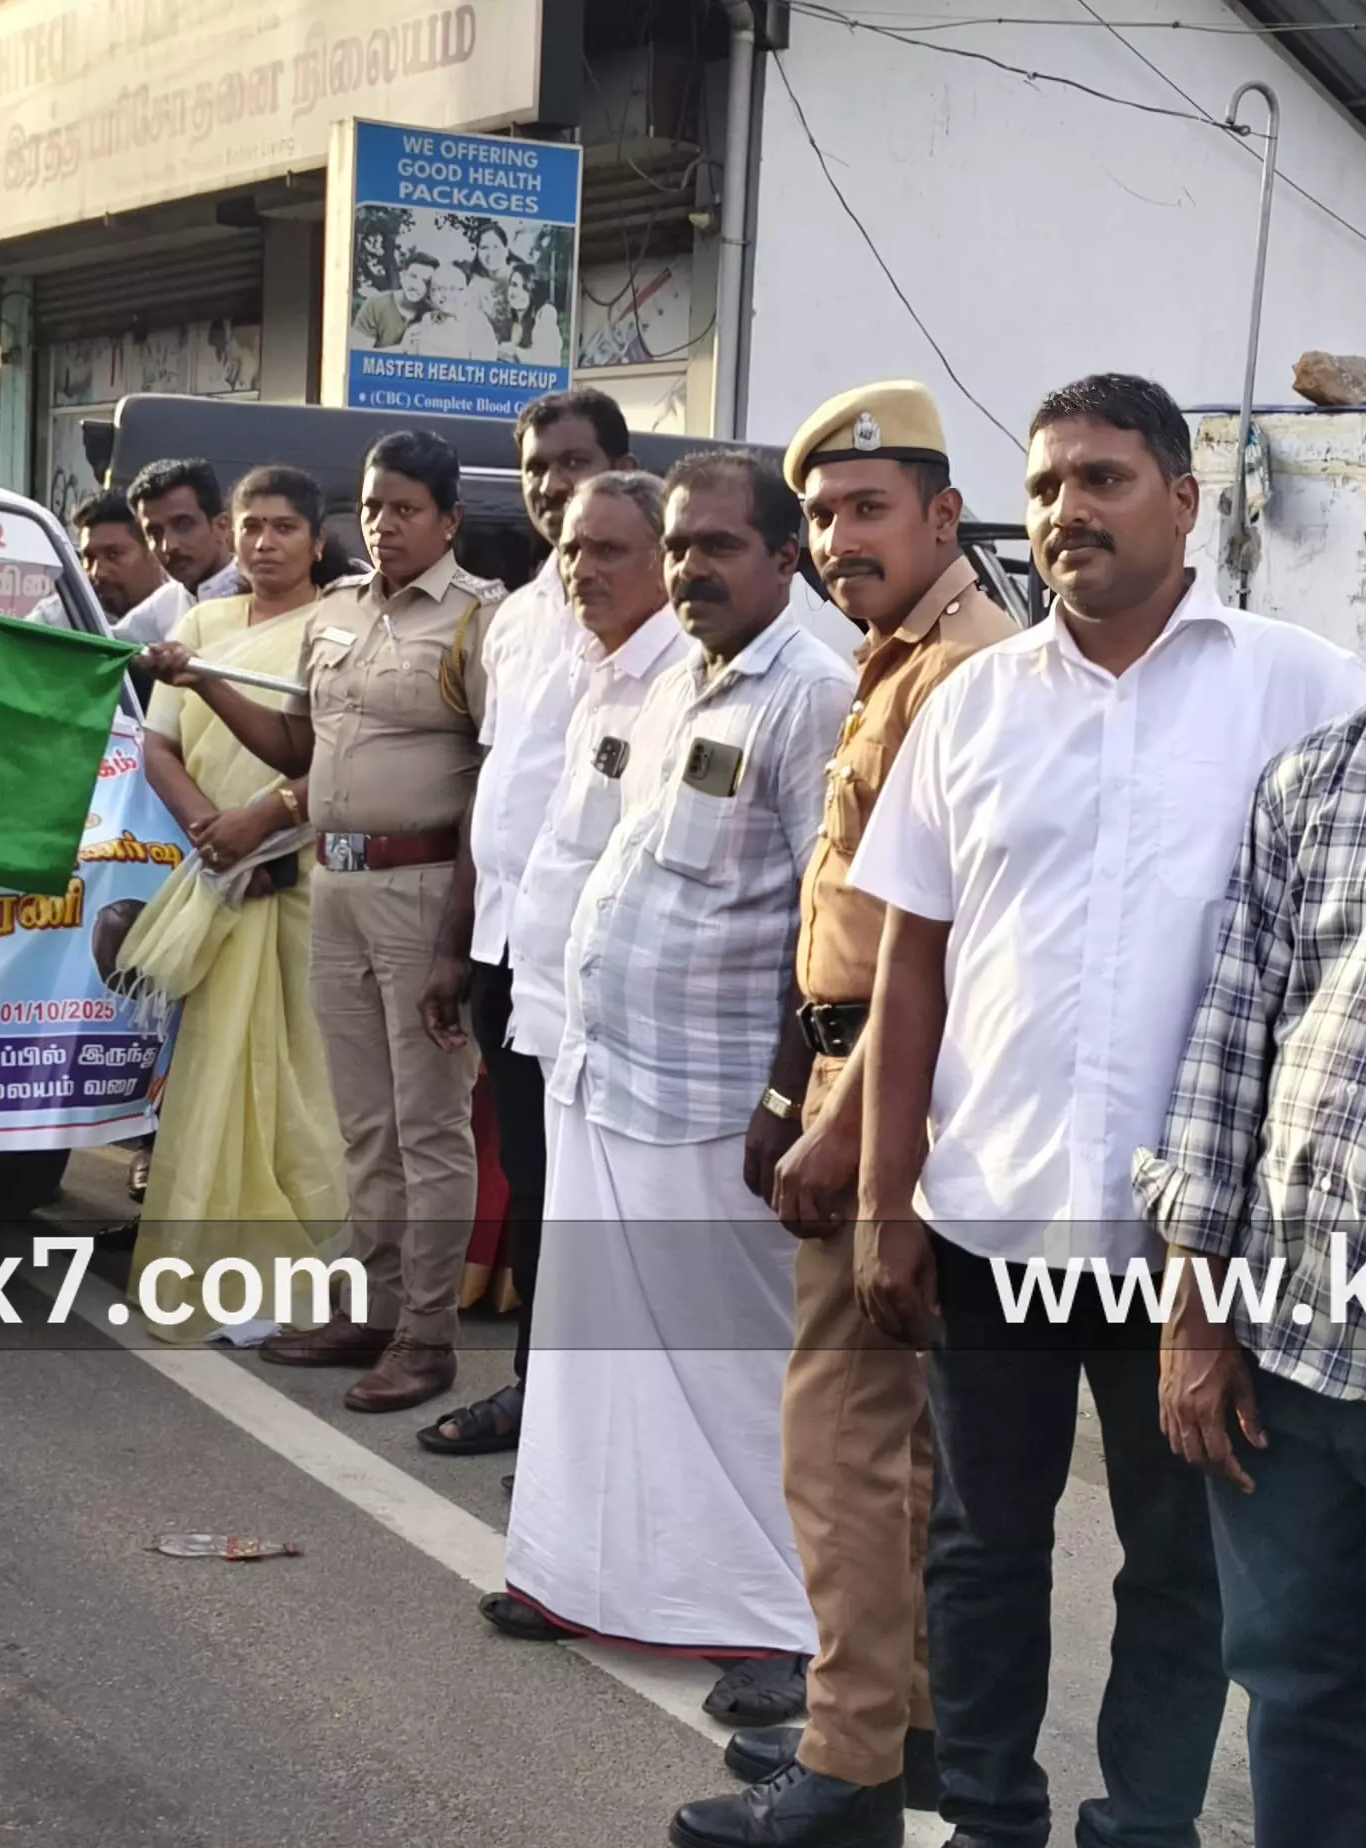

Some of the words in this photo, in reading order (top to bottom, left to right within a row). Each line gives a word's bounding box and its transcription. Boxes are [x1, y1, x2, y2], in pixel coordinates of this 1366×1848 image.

[261, 137, 295, 158] Living
[403, 135, 434, 156] WE
[440, 140, 539, 169] OFFERING
[397, 158, 462, 182] GOOD
[468, 166, 542, 192] HEALTH
[398, 181, 540, 213] PACKAGES
[362, 356, 424, 379] MASTER
[427, 362, 485, 386] HEALTH
[488, 370, 558, 390] CHECKUP
[370, 390, 411, 407] (CBC)
[413, 394, 474, 412] Complete
[476, 397, 511, 414] Blood
[1, 1001, 115, 1023] 01/10/2025
[84, 1077, 137, 1097] வரை
